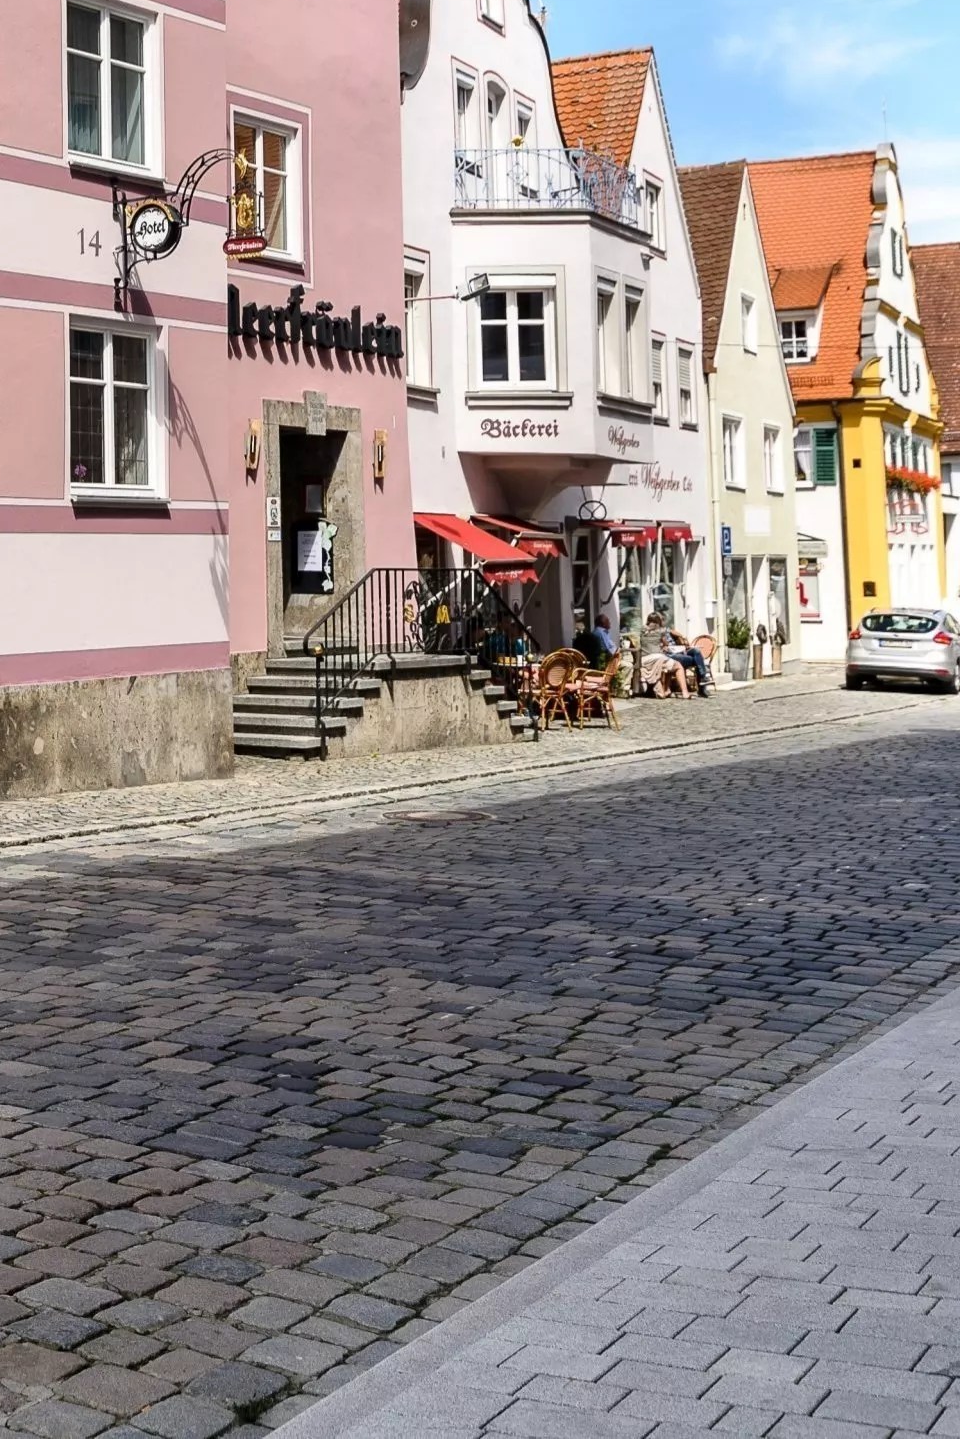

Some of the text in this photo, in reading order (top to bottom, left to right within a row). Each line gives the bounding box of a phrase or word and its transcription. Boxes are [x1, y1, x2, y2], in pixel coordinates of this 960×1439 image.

[136, 217, 166, 239] Hotel
[77, 228, 102, 257] 14
[481, 418, 560, 439] Bäckerei
